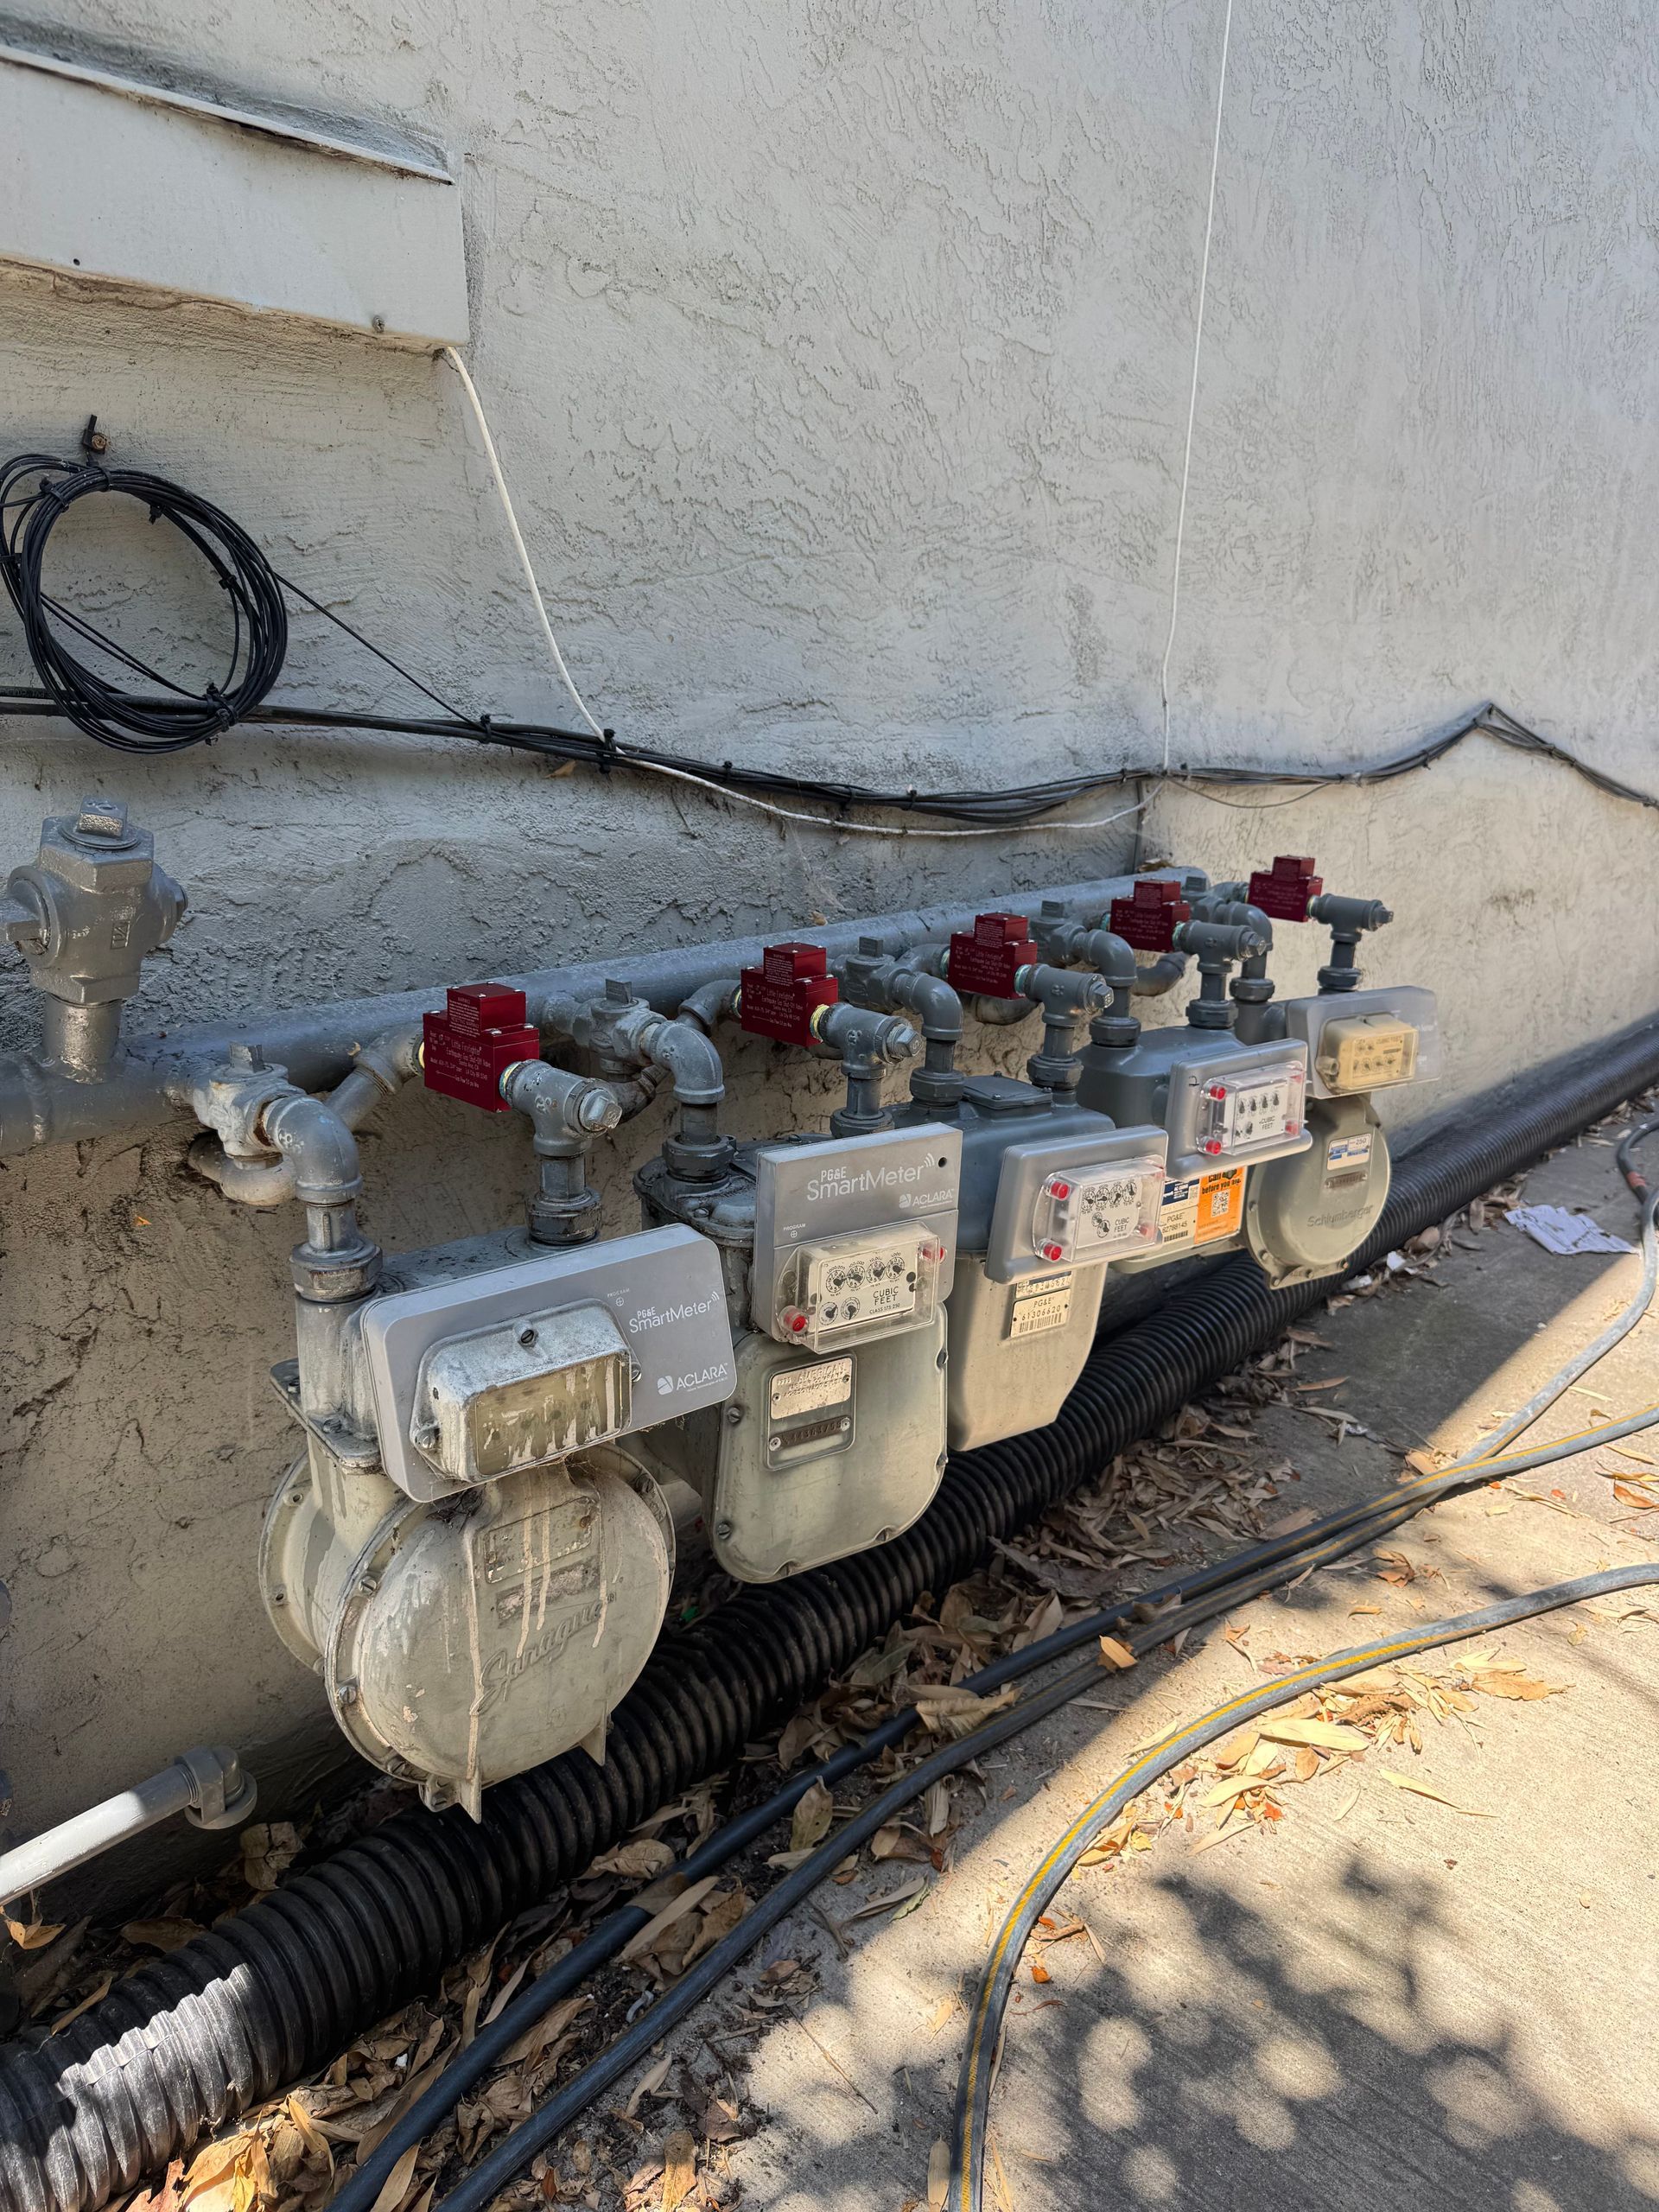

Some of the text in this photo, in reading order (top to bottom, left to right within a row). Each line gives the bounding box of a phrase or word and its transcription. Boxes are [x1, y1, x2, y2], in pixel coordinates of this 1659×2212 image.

[821, 1166, 847, 1182] PG&E
[807, 1165, 925, 1201] SmartMeter
[1306, 1205, 1373, 1227] Schlumberger
[783, 1223, 806, 1231] PROGRAM
[607, 1287, 630, 1298] PROGRAM
[873, 1286, 899, 1299] CUBIC
[874, 1294, 897, 1306] FEET
[1033, 1297, 1052, 1307] PG&E
[629, 1300, 712, 1333] SmartMeter
[637, 1306, 657, 1319] PG&E
[1022, 1305, 1061, 1320] 61306620
